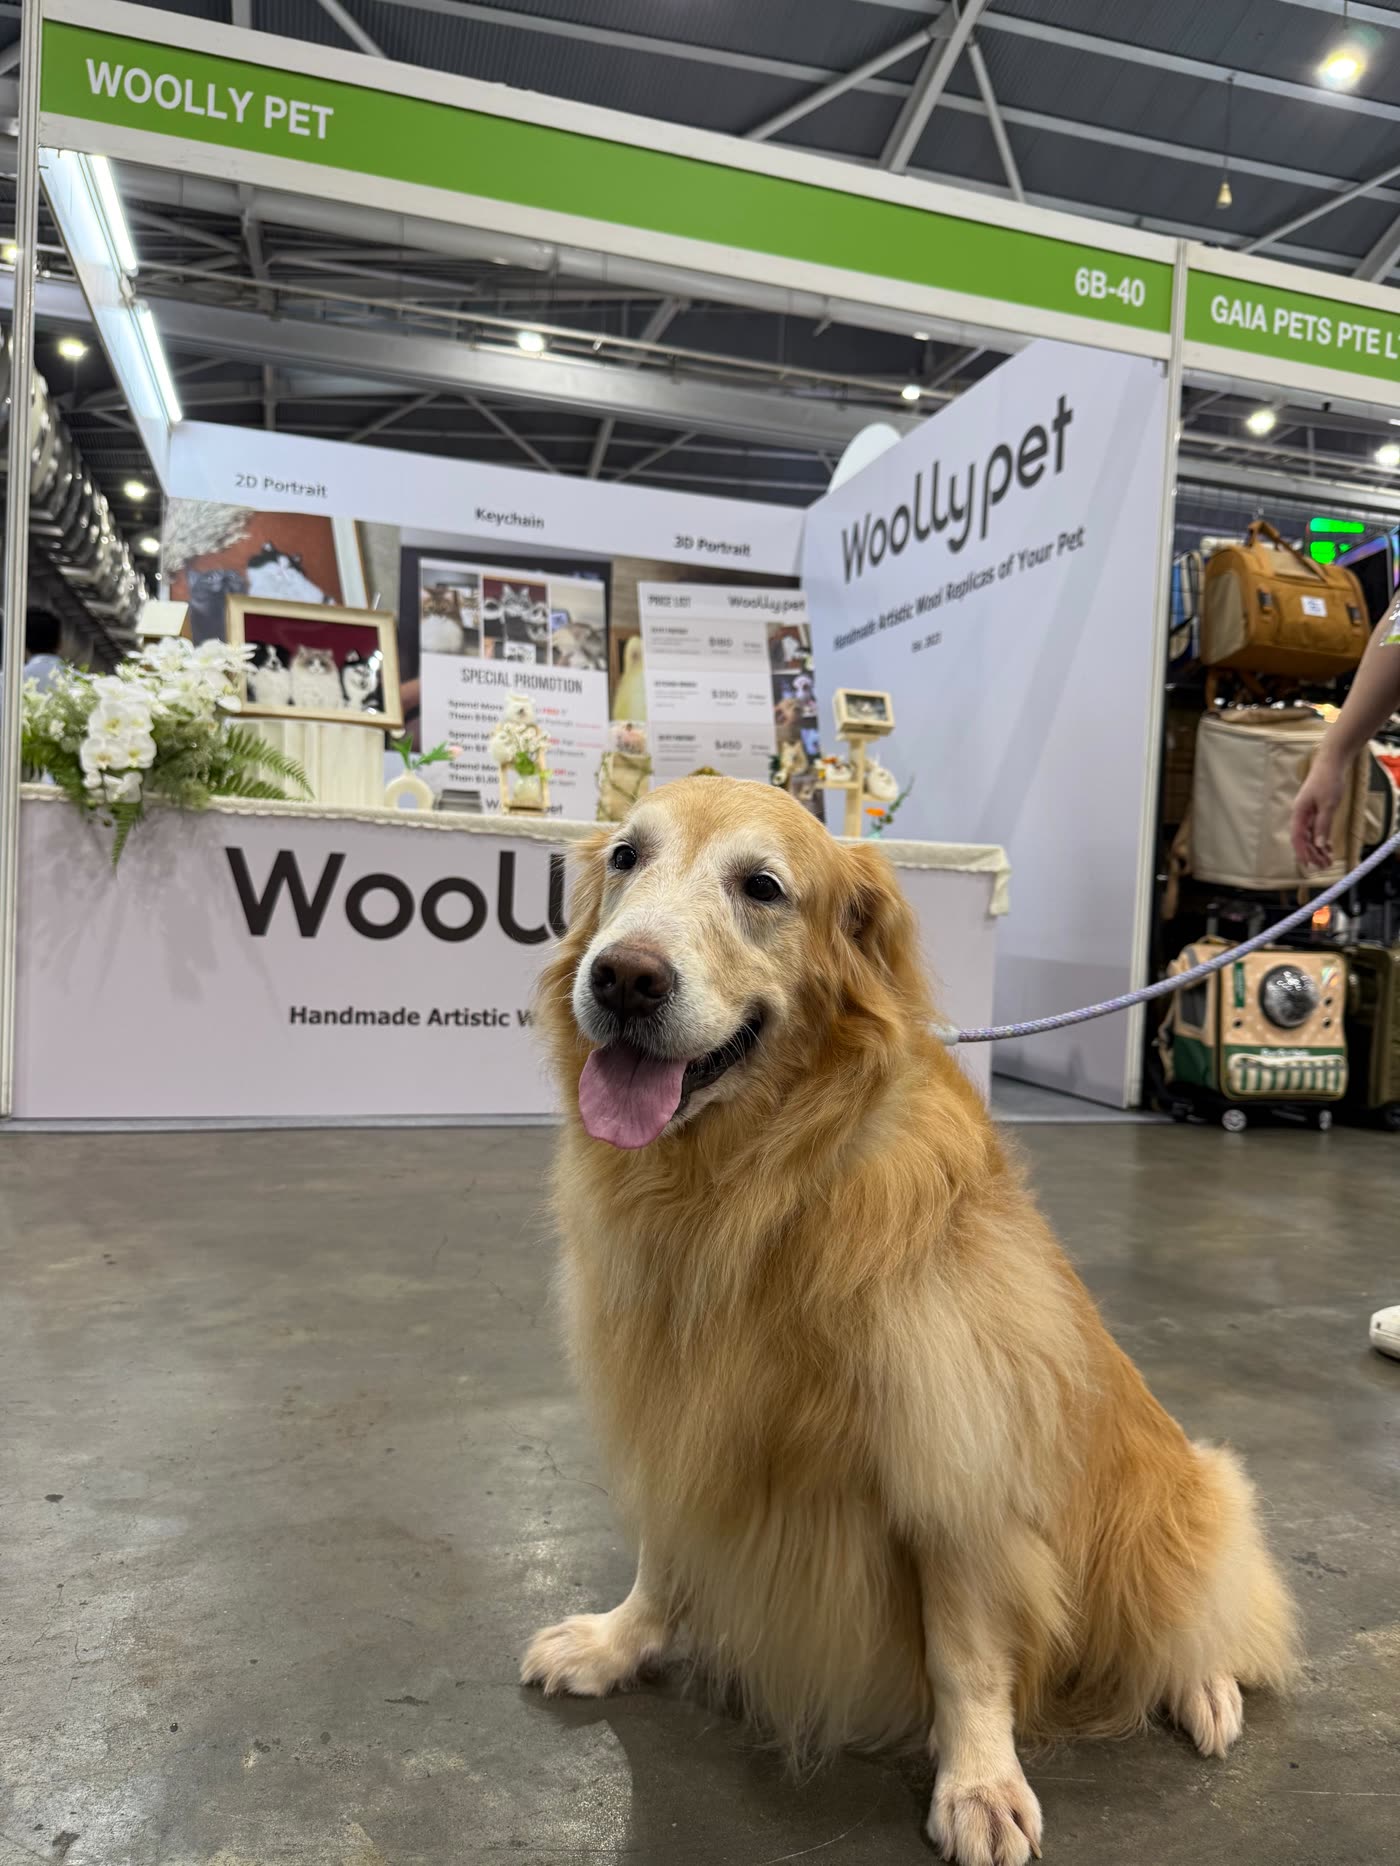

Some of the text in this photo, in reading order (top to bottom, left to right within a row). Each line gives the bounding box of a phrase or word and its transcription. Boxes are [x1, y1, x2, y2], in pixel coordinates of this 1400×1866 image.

[85, 58, 334, 139] WOOLLY PET
[1075, 266, 1145, 307] 6B-40
[1210, 294, 1400, 360] GAIA PETS PTE L
[234, 473, 328, 498] 2D Portrait
[842, 394, 1073, 585] Woollypet
[475, 507, 544, 529] Keychain
[673, 534, 751, 557] 3D Portrait
[945, 566, 995, 602] Replicas
[997, 554, 1015, 580] of
[1017, 543, 1054, 572] Your
[1057, 526, 1085, 556] Pet
[728, 595, 805, 614] Woollypet
[461, 668, 582, 693] SPECIAL PROMOTION
[225, 846, 567, 945] Wooll
[290, 1005, 420, 1026] Handmade
[427, 1006, 510, 1027] Artistic
